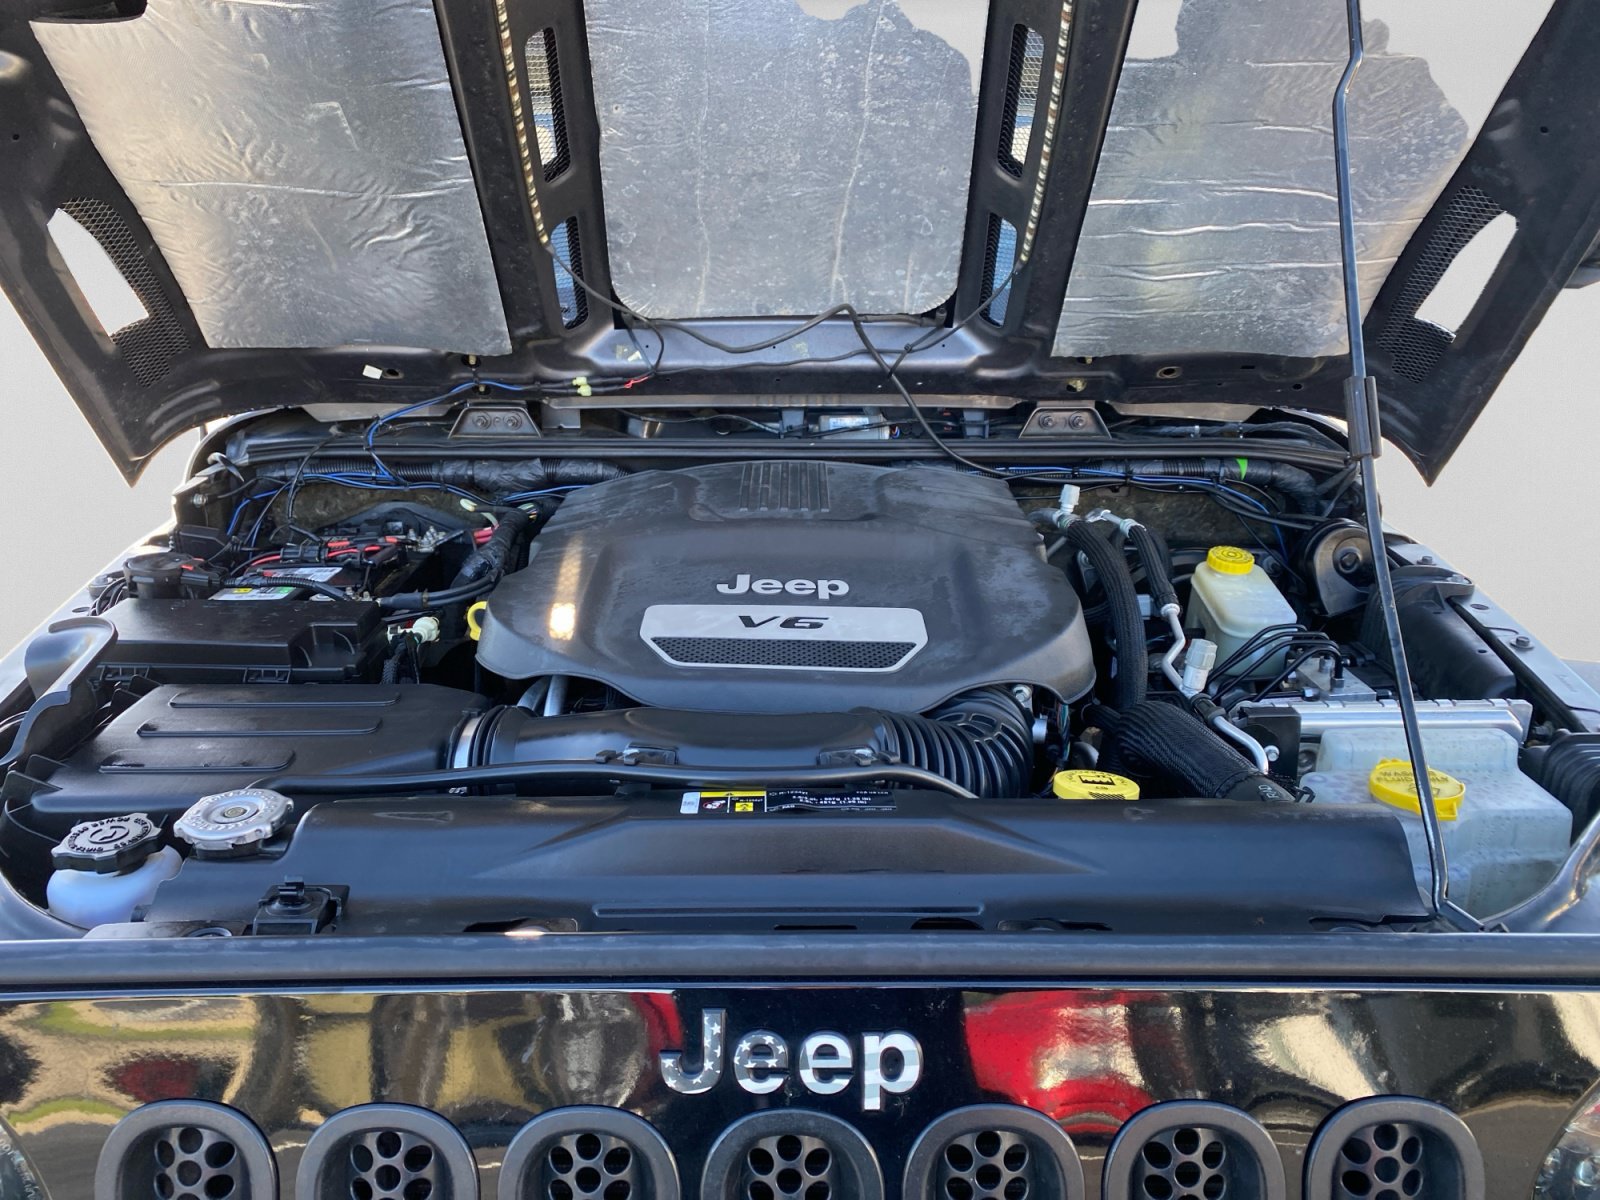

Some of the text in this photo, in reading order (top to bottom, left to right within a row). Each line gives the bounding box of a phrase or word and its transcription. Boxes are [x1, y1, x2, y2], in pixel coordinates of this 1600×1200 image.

[716, 574, 850, 600] Jeep
[738, 615, 829, 629] V6
[660, 1007, 923, 1111] Jeep
